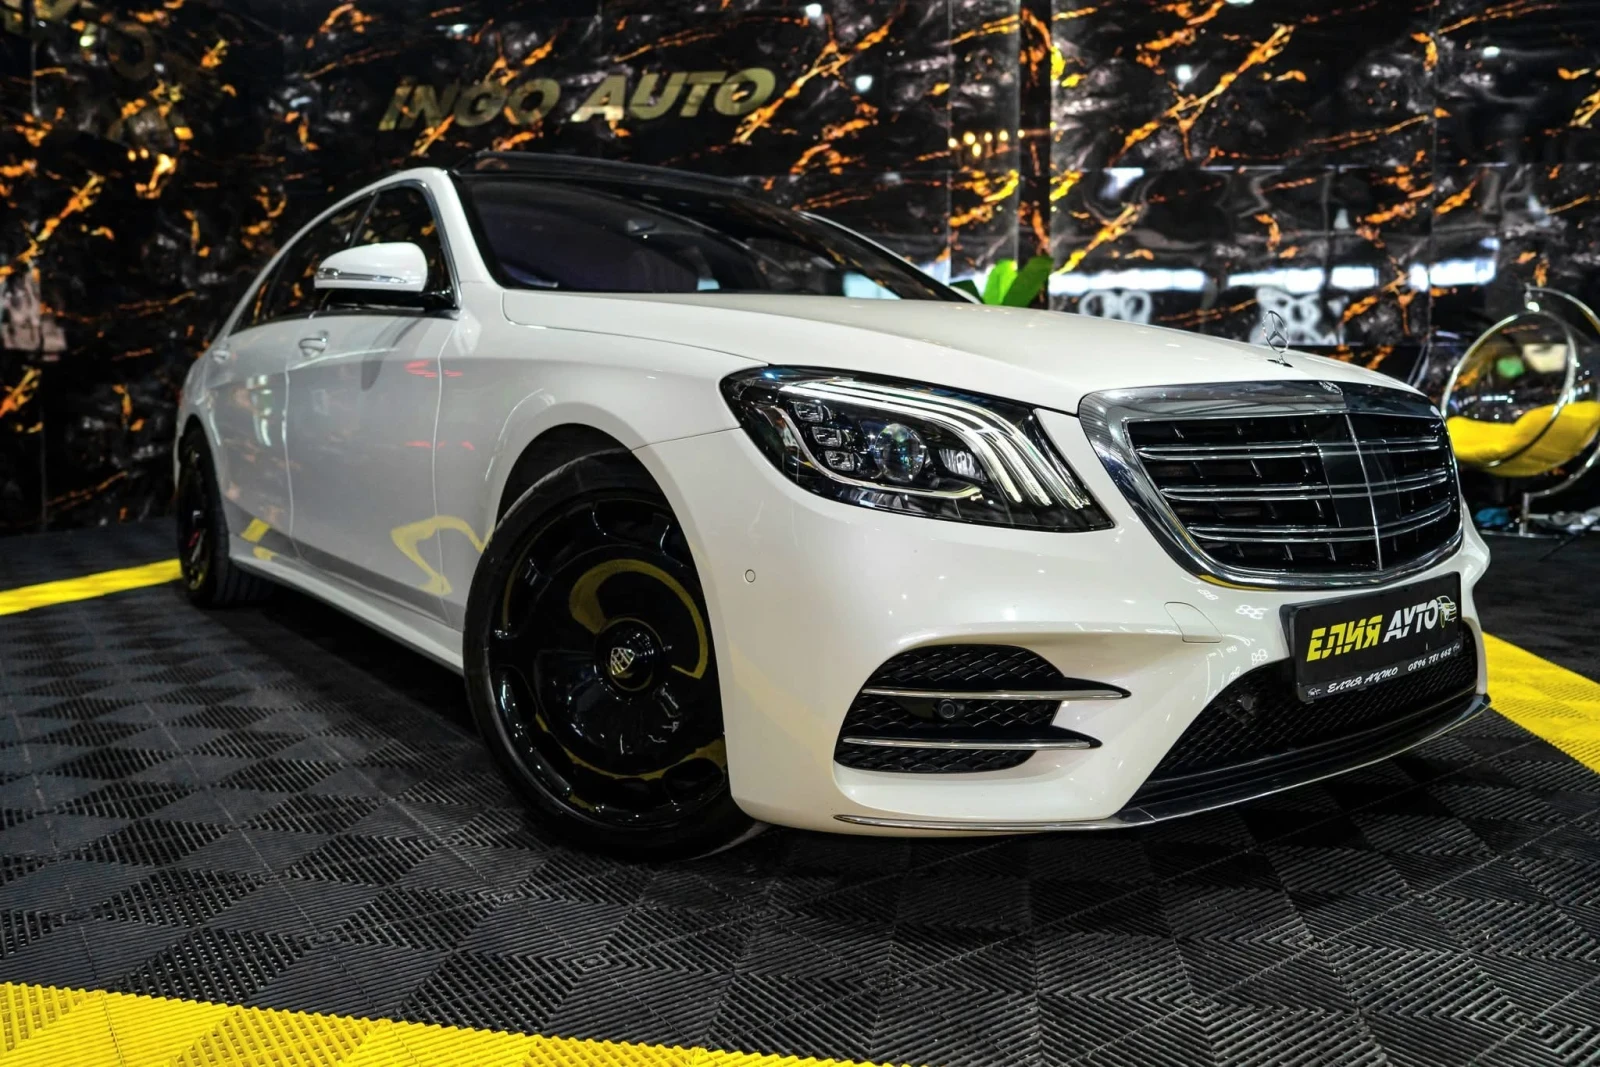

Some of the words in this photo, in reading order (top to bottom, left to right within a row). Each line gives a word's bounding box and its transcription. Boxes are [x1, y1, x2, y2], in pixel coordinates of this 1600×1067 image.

[378, 77, 561, 131] INGO
[570, 67, 776, 122] AUTO
[1306, 614, 1384, 662] ЕЛИЯ
[1383, 599, 1439, 643] АУТО
